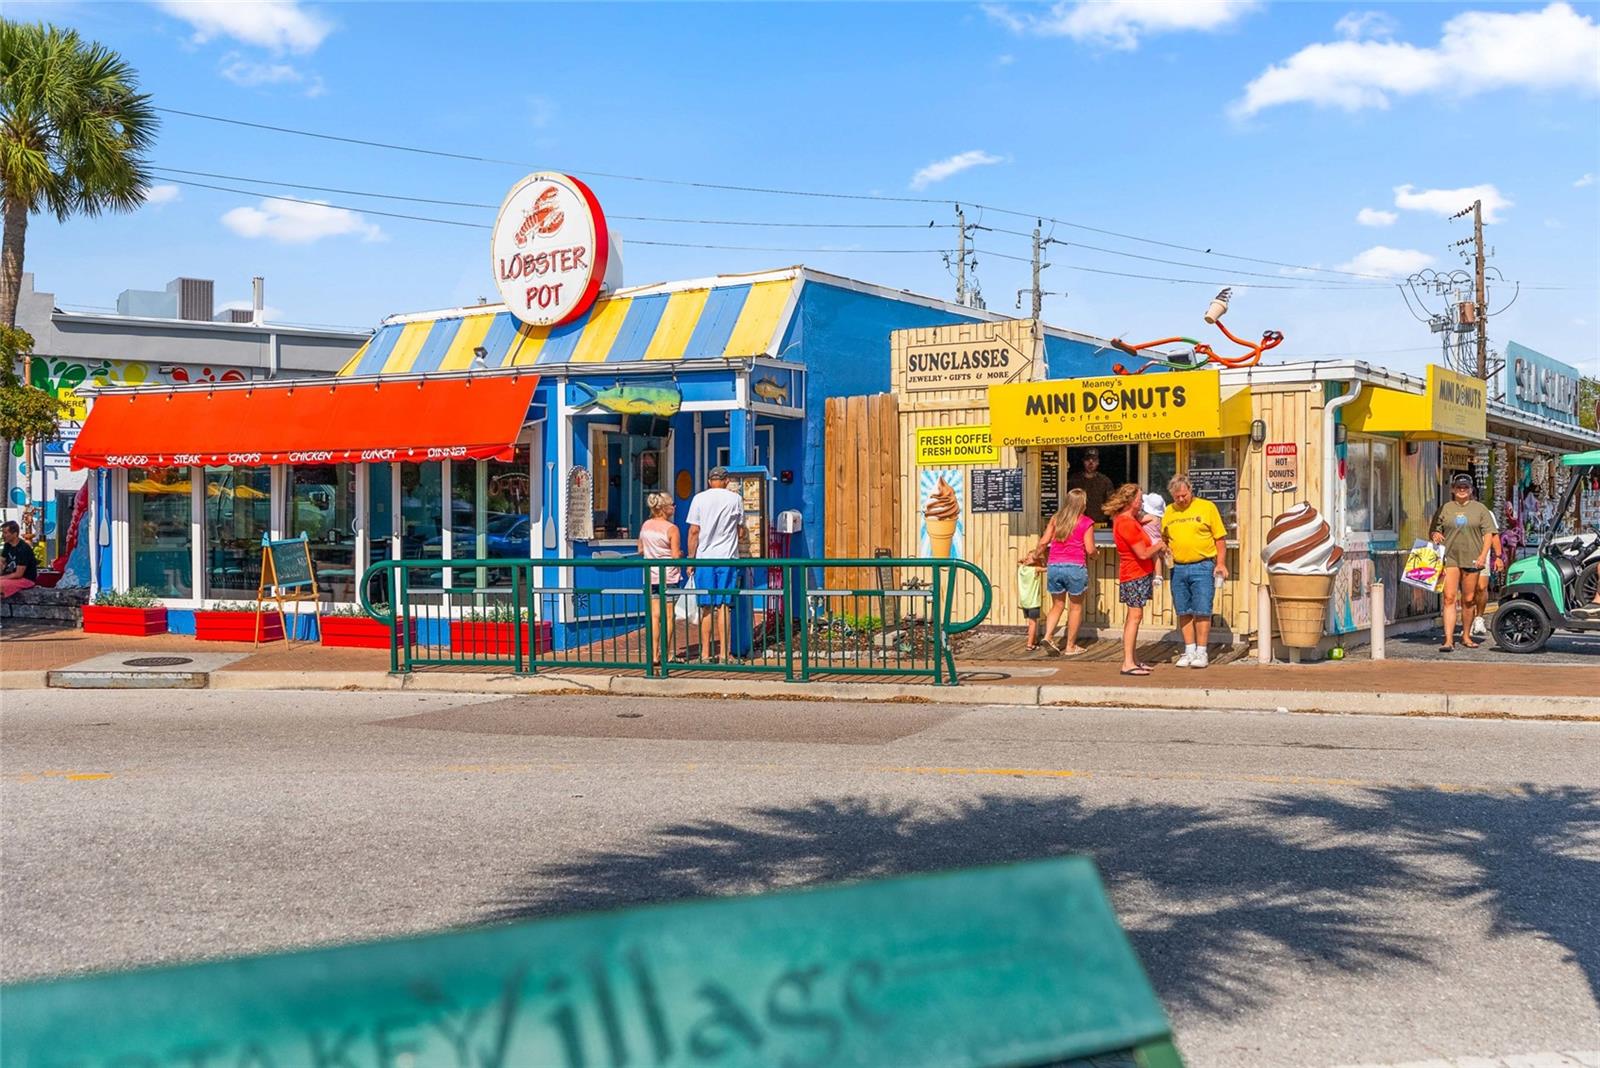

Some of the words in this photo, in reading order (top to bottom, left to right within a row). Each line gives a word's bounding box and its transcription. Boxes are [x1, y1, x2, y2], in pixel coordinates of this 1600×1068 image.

[500, 246, 588, 280] LOBSTER
[525, 283, 564, 310] POT
[908, 348, 1010, 373] SUNGLASSES
[908, 374, 943, 384] JEWELRY
[949, 373, 972, 381] GIFTS
[987, 371, 1010, 379] MORE
[1082, 378, 1123, 389] Meaney's
[1025, 392, 1076, 416] MINI
[1082, 385, 1187, 412] DONUTS
[1439, 378, 1455, 403] MINI
[1456, 383, 1482, 410] DONUTS
[1060, 414, 1110, 423] Coffee
[1121, 411, 1167, 420] House
[920, 437, 952, 446] FRESH
[1003, 437, 1031, 446] Coffee
[1035, 436, 1075, 445] Espresso
[1080, 434, 1093, 443] Ice
[1095, 432, 1124, 442] Coffee
[1157, 430, 1171, 440] Ice
[1174, 429, 1205, 439] Cream
[106, 455, 149, 465] SEAFOOD
[173, 454, 201, 464] STEAK
[227, 453, 262, 463] CHOPS
[288, 451, 332, 462] CHICKEN
[361, 449, 397, 460] LUNCH
[427, 447, 467, 458] DINNER
[922, 447, 952, 456] FRESH
[954, 445, 993, 455] DONUTS
[1267, 445, 1296, 454] CAUTION
[1275, 458, 1288, 466] HOT
[1269, 469, 1294, 478] DONUTS
